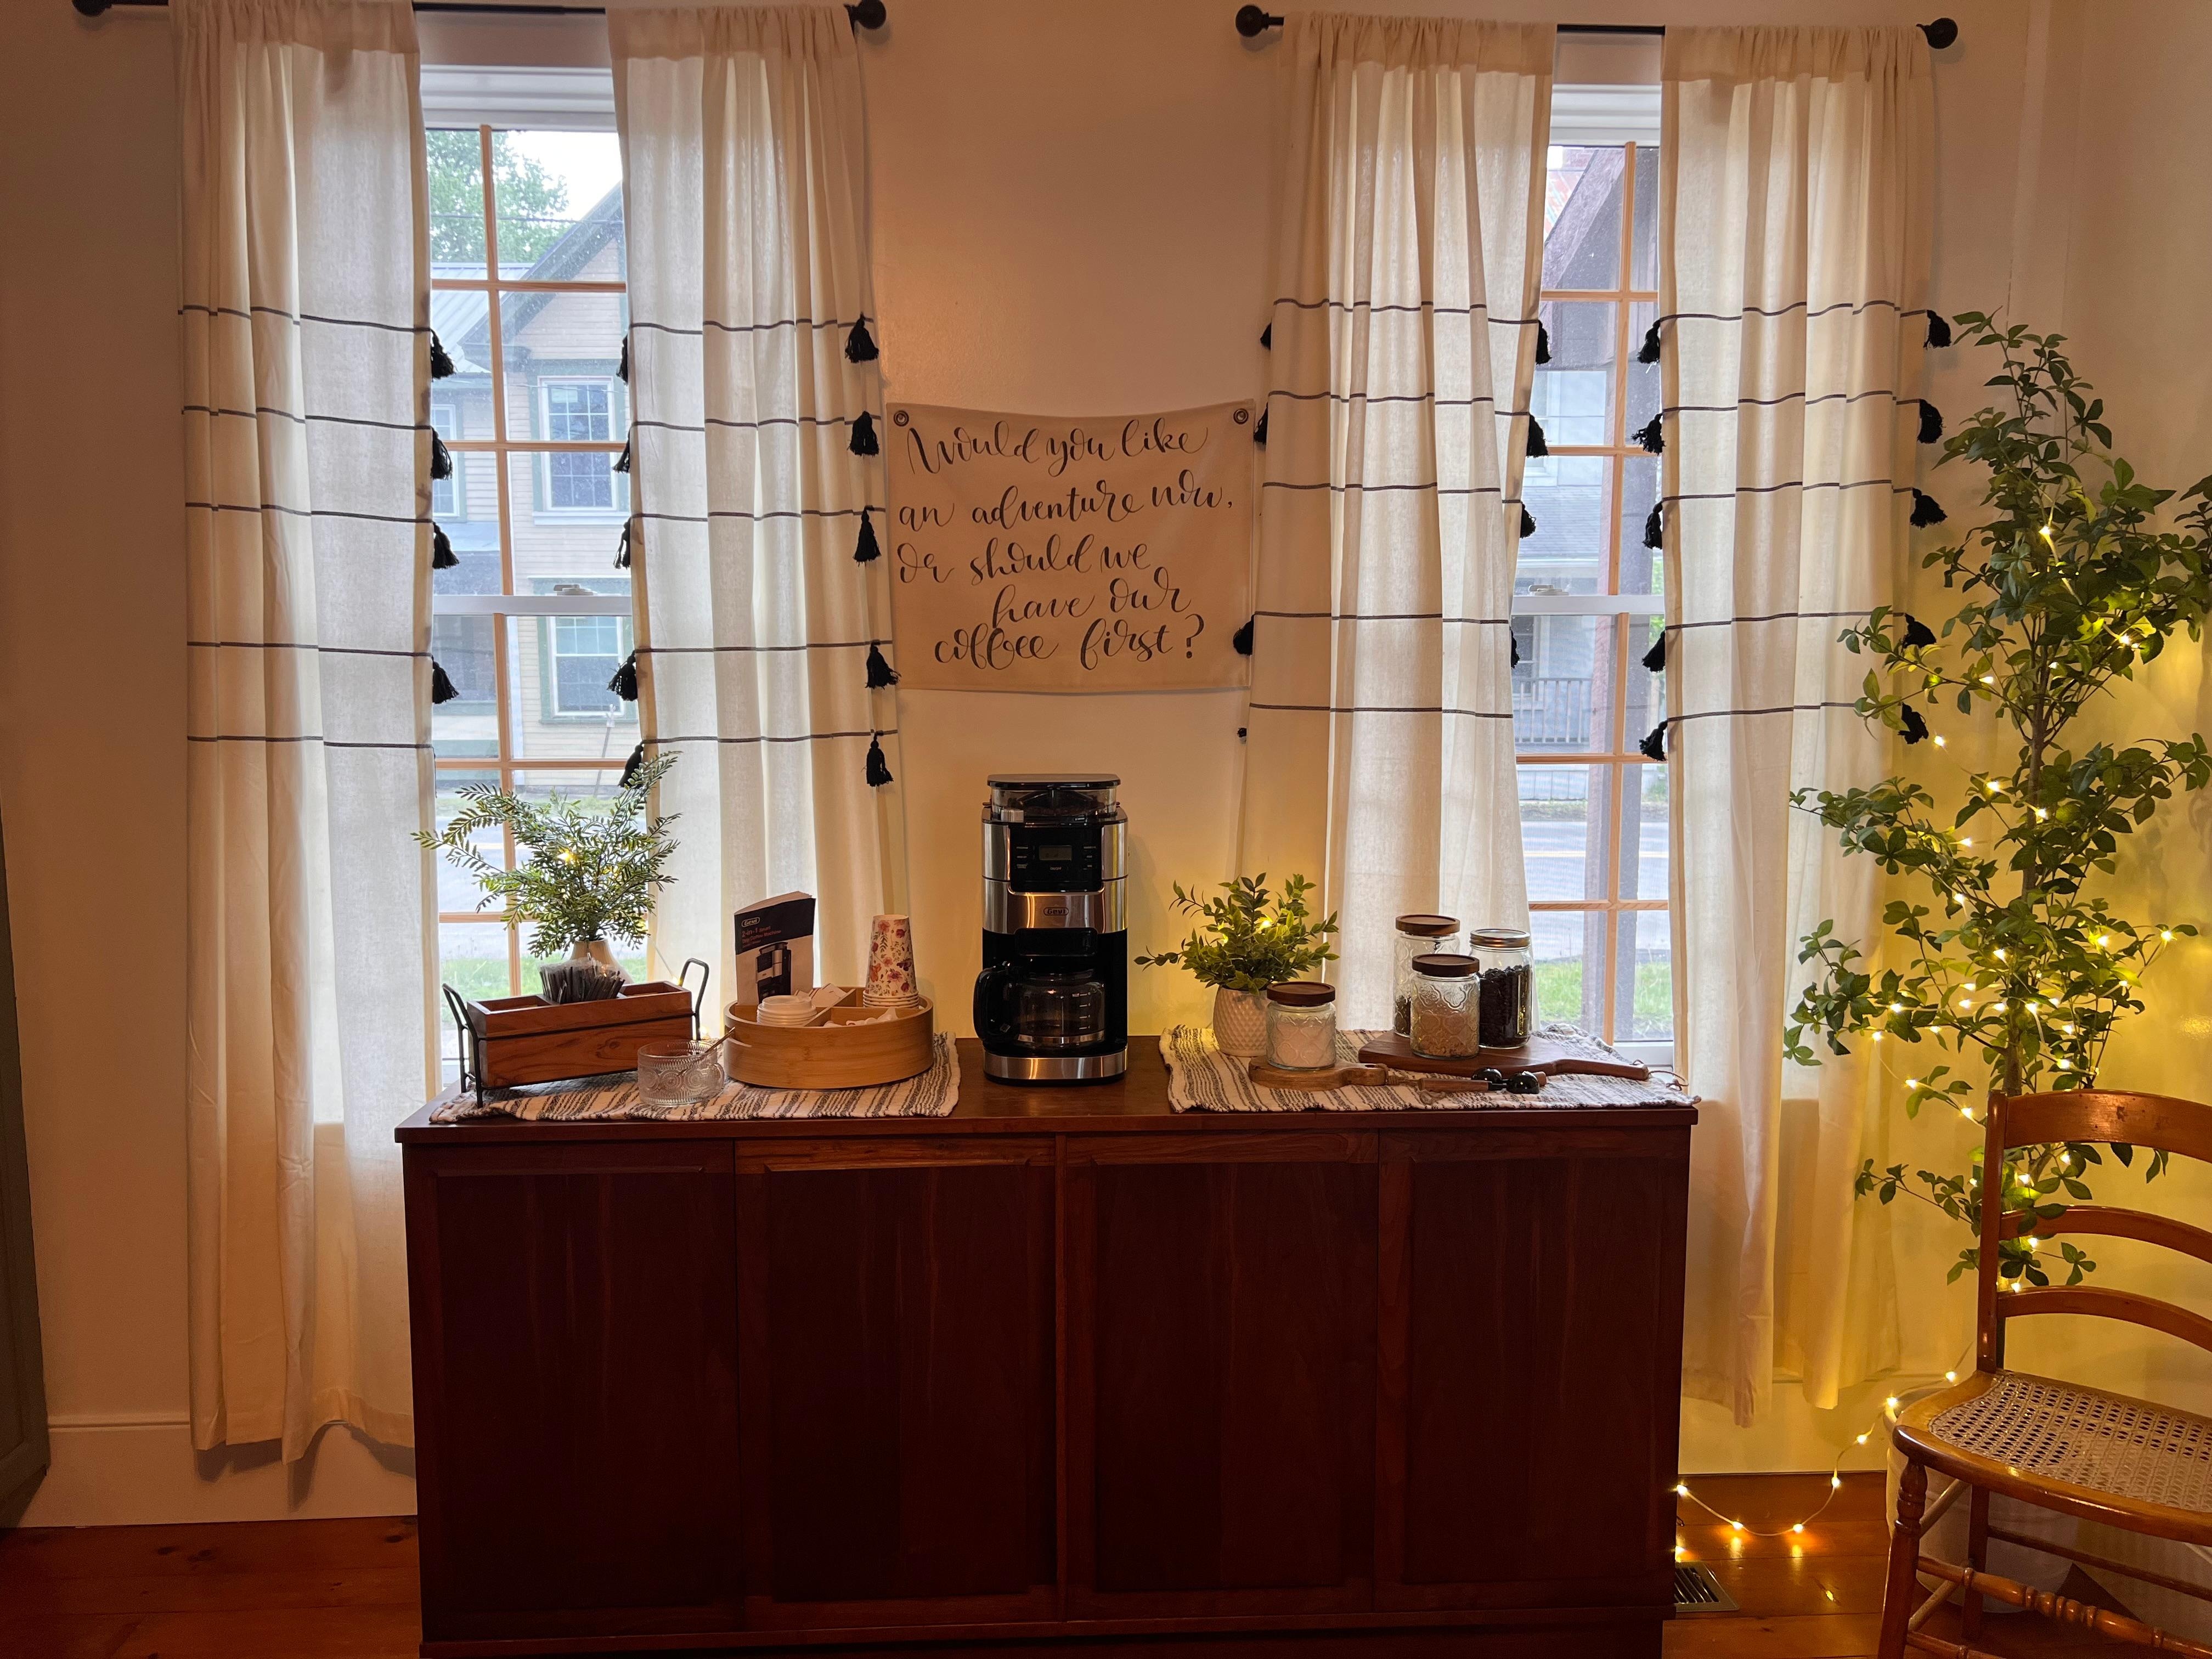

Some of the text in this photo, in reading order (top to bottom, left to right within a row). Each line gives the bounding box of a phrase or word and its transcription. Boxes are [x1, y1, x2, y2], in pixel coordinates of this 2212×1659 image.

[907, 417, 1208, 477] Would you like
[899, 469, 1233, 532] an adventure now,
[970, 534, 1094, 586] should
[1100, 543, 1152, 574] we
[992, 567, 1192, 629] have our
[934, 613, 1205, 670] coffee first?
